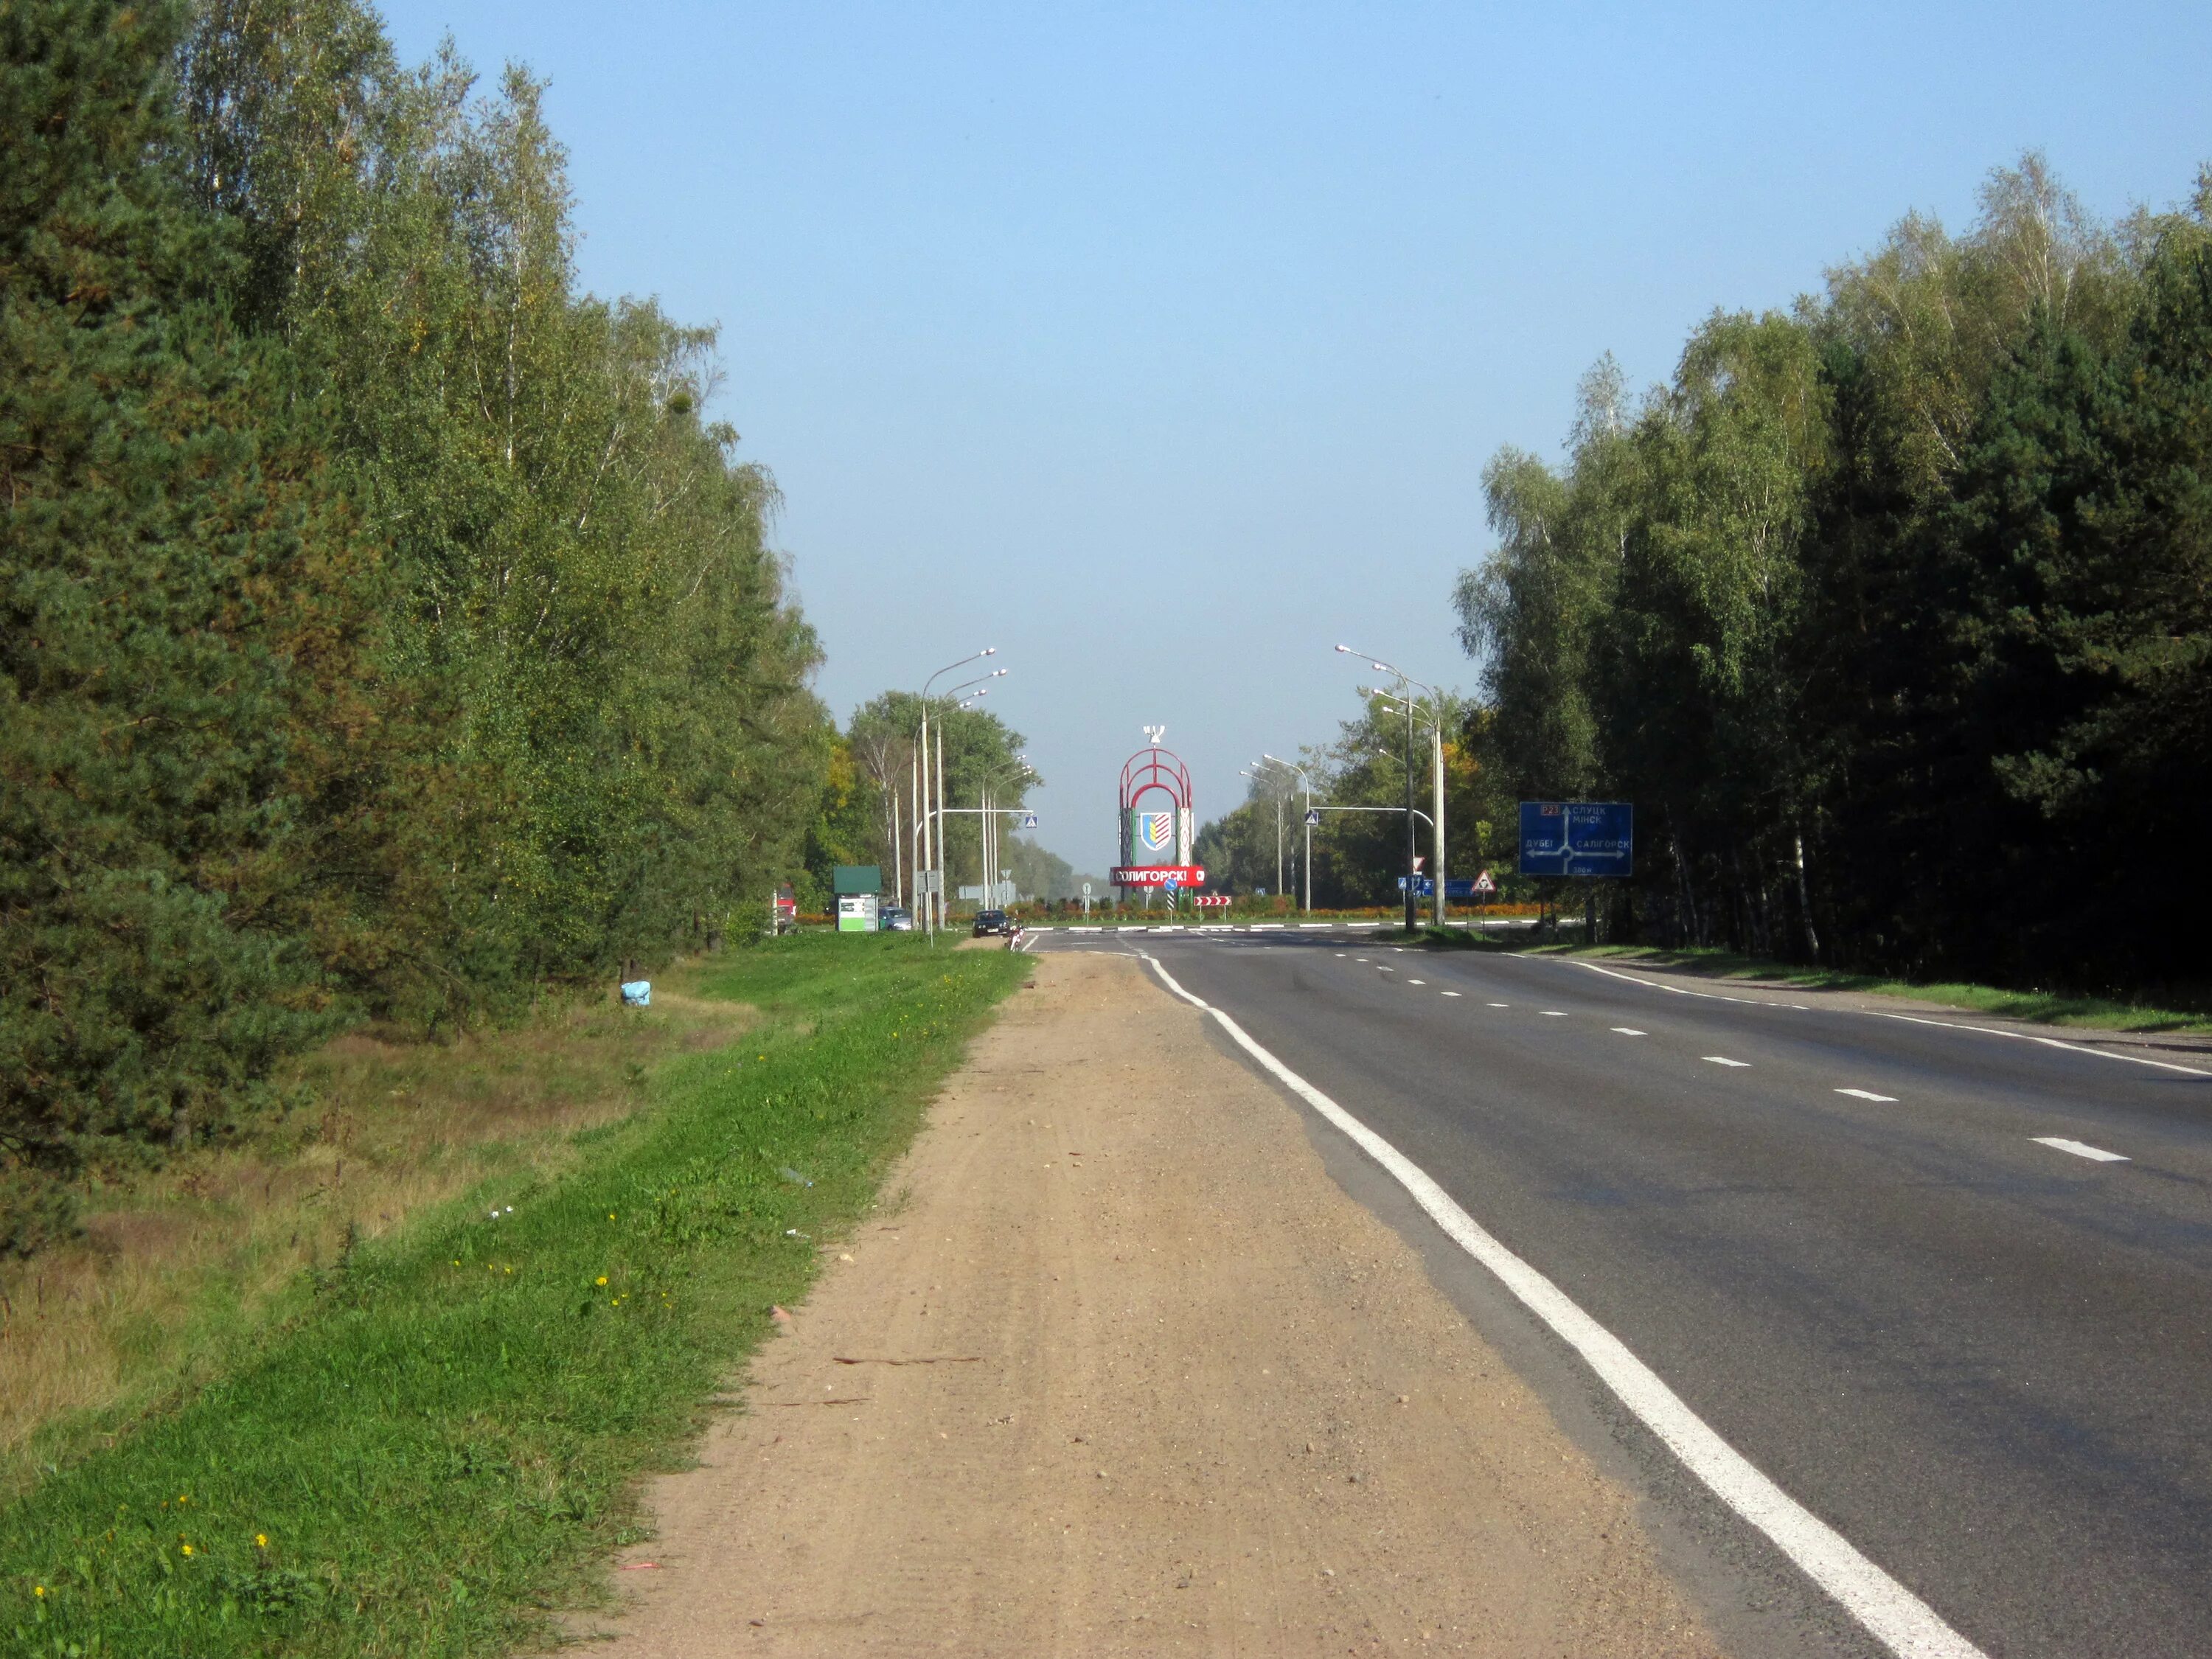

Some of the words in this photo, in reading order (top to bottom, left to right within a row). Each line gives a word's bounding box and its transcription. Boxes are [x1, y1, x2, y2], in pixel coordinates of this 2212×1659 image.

[1572, 807, 1606, 815] СЛУЦК
[1572, 815, 1601, 824] МІНСК
[1576, 840, 1630, 849] САЛІГОРСК
[1116, 871, 1187, 882] СОЛИГОРСК!
